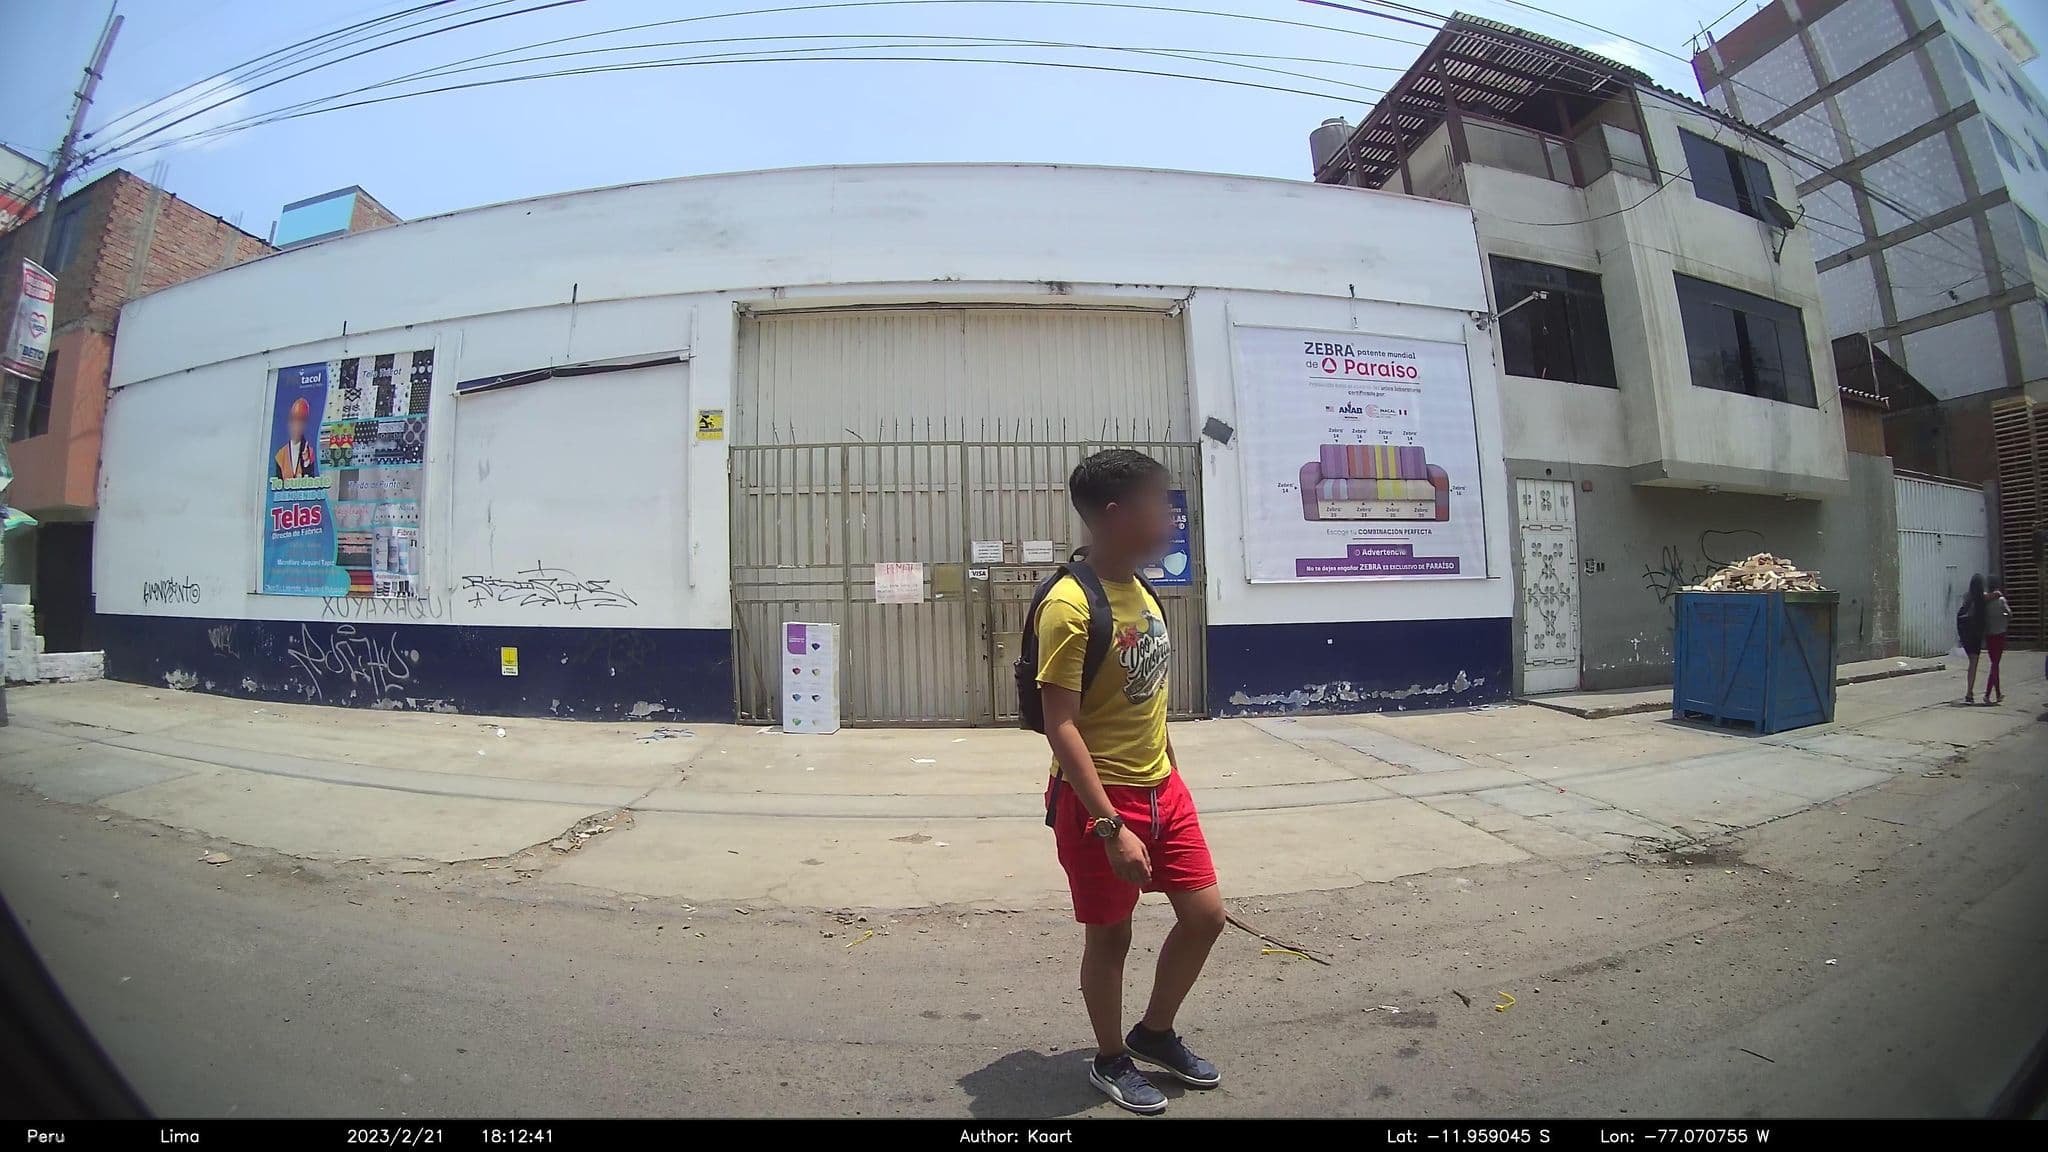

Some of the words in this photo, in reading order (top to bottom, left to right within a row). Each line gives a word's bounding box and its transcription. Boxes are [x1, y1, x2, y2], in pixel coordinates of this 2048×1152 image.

[1304, 341, 1355, 357] ZEBRA
[1357, 349, 1386, 359] patente
[1387, 351, 1416, 359] mundial
[1306, 359, 1319, 369] de
[271, 503, 322, 531] Telas
[1359, 563, 1382, 571] ZEBRA
